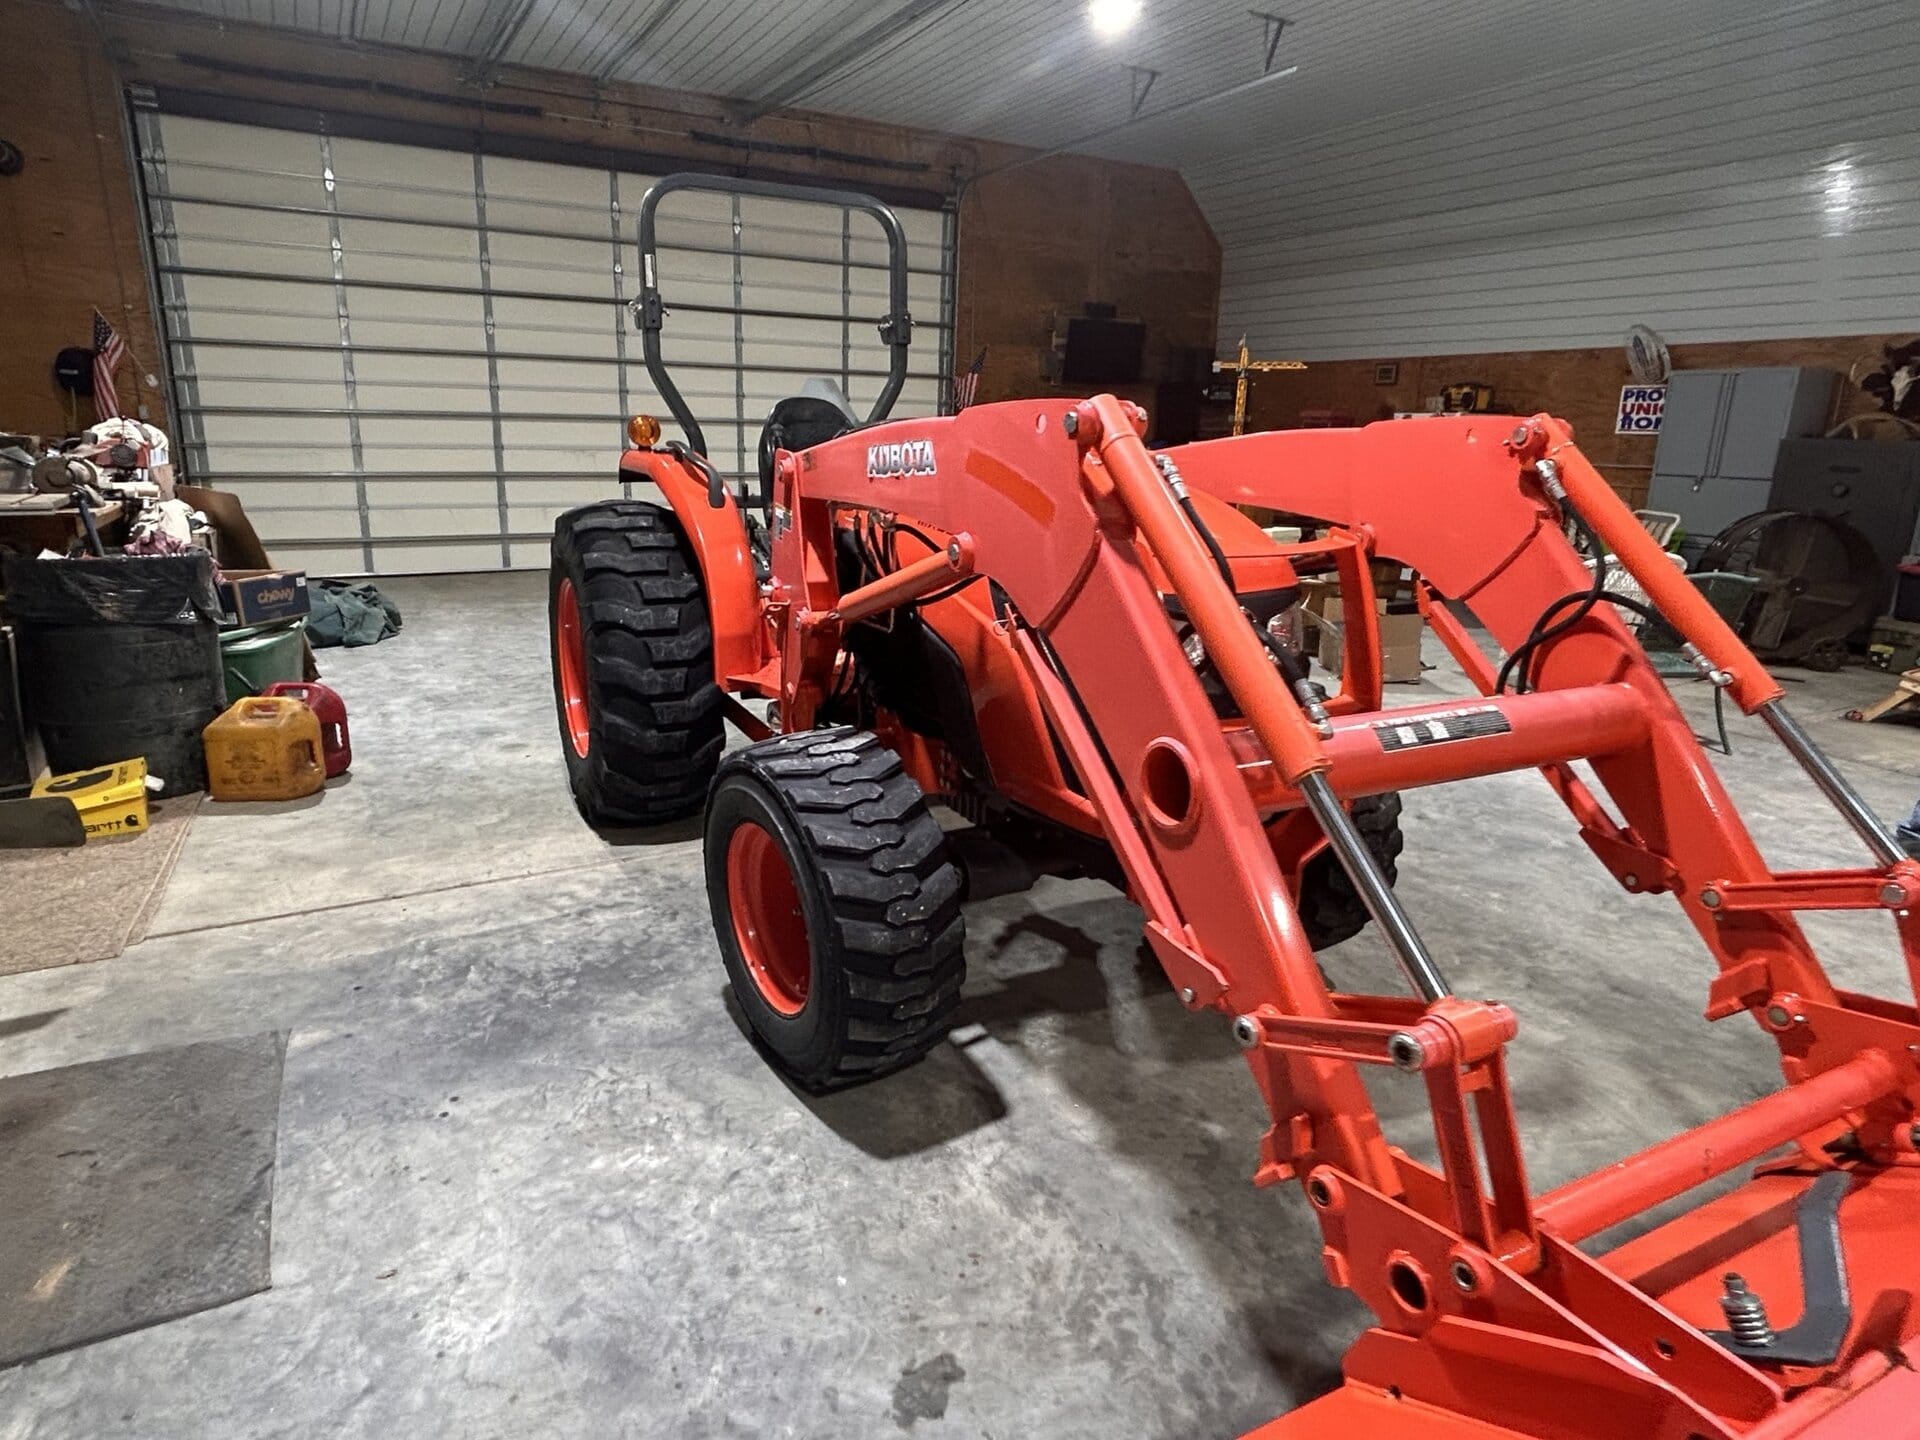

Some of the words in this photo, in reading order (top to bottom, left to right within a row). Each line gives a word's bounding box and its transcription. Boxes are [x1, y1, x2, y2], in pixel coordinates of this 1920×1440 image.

[1623, 390, 1663, 402] PRO
[1621, 403, 1664, 416] UNI
[867, 440, 937, 477] KUBOTA
[84, 820, 122, 833] artt
